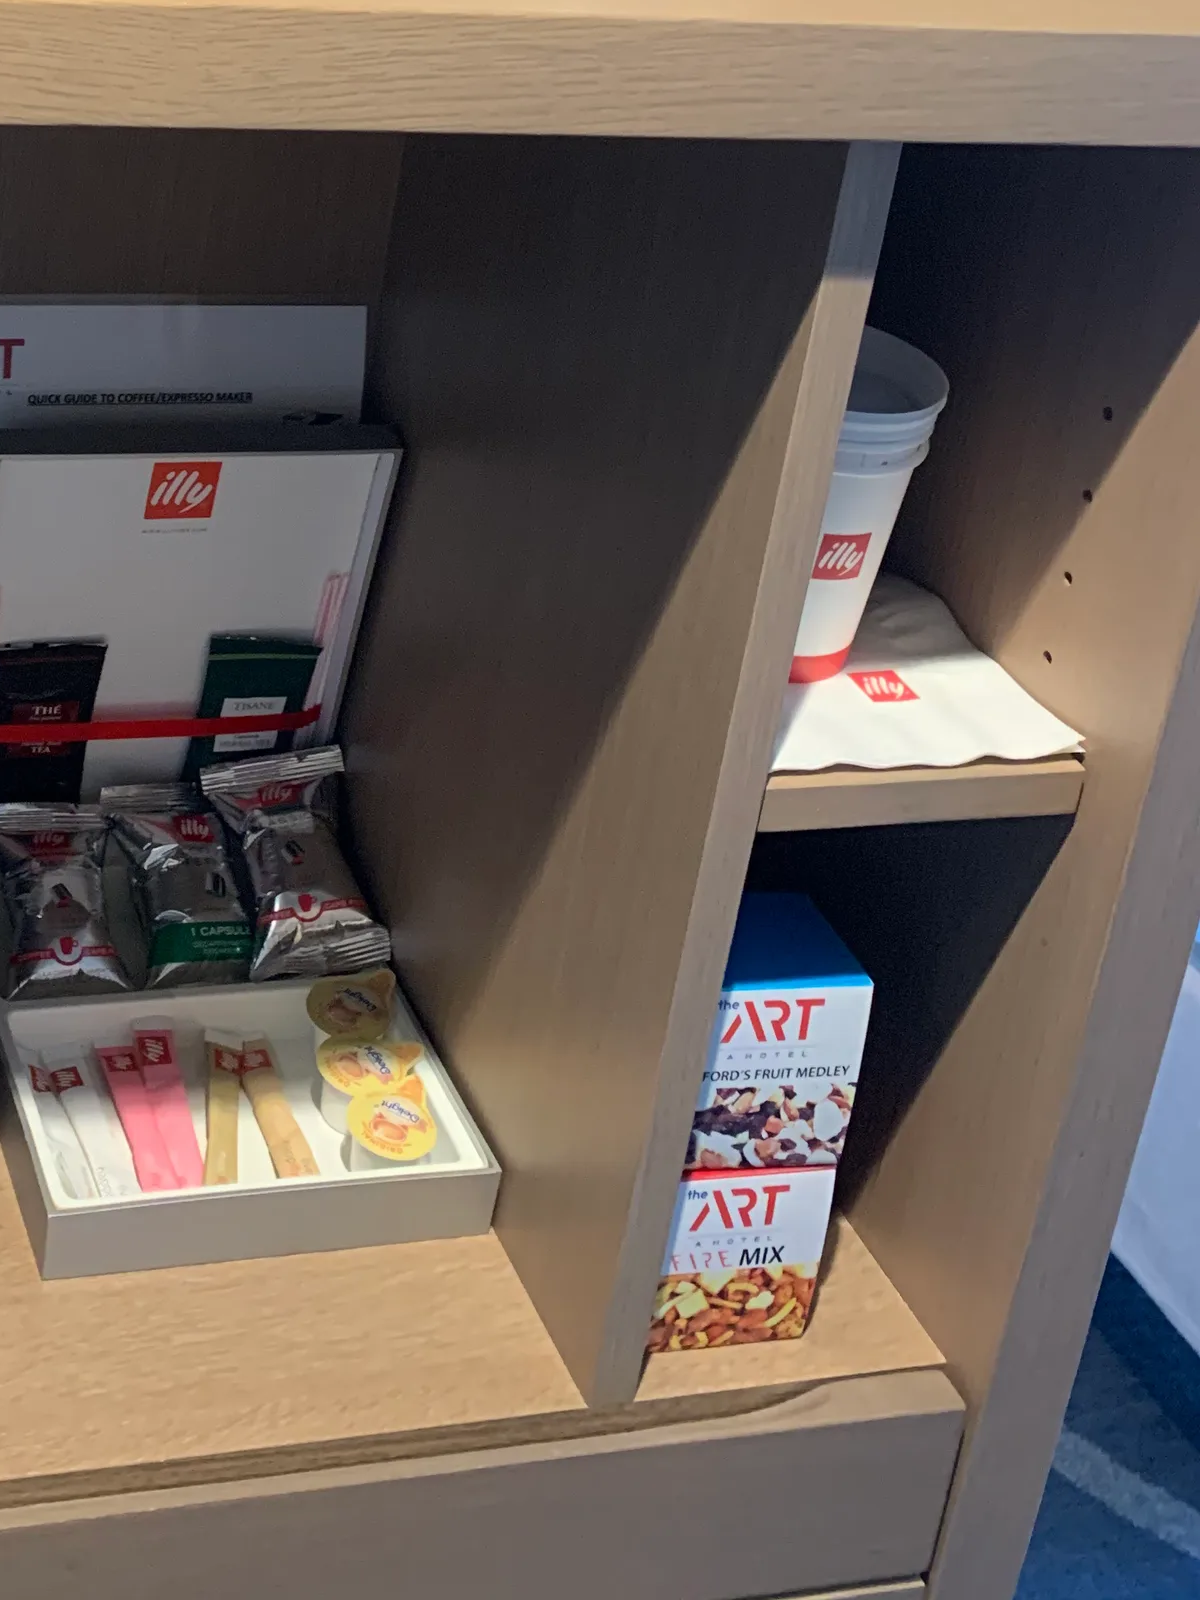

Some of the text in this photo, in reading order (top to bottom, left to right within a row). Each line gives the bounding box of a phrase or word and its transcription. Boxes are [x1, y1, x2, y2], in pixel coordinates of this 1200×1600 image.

[28, 392, 252, 404] QUICK GUIDE TO COFFEE/EXPRESSO MAKER
[150, 469, 213, 514] illy
[818, 542, 863, 576] illy
[863, 675, 905, 699] illy
[261, 784, 293, 802] illy
[180, 819, 210, 838] illy
[718, 998, 826, 1043] the ART
[144, 1037, 165, 1062] illy
[745, 1051, 809, 1060] HOTEL
[754, 1067, 793, 1080] FRUIT
[796, 1065, 851, 1078] MEDLEY
[380, 1099, 420, 1124] Delight
[688, 1185, 791, 1232] the ART
[712, 1236, 773, 1246] HOTEL
[739, 1245, 785, 1267] MIX
